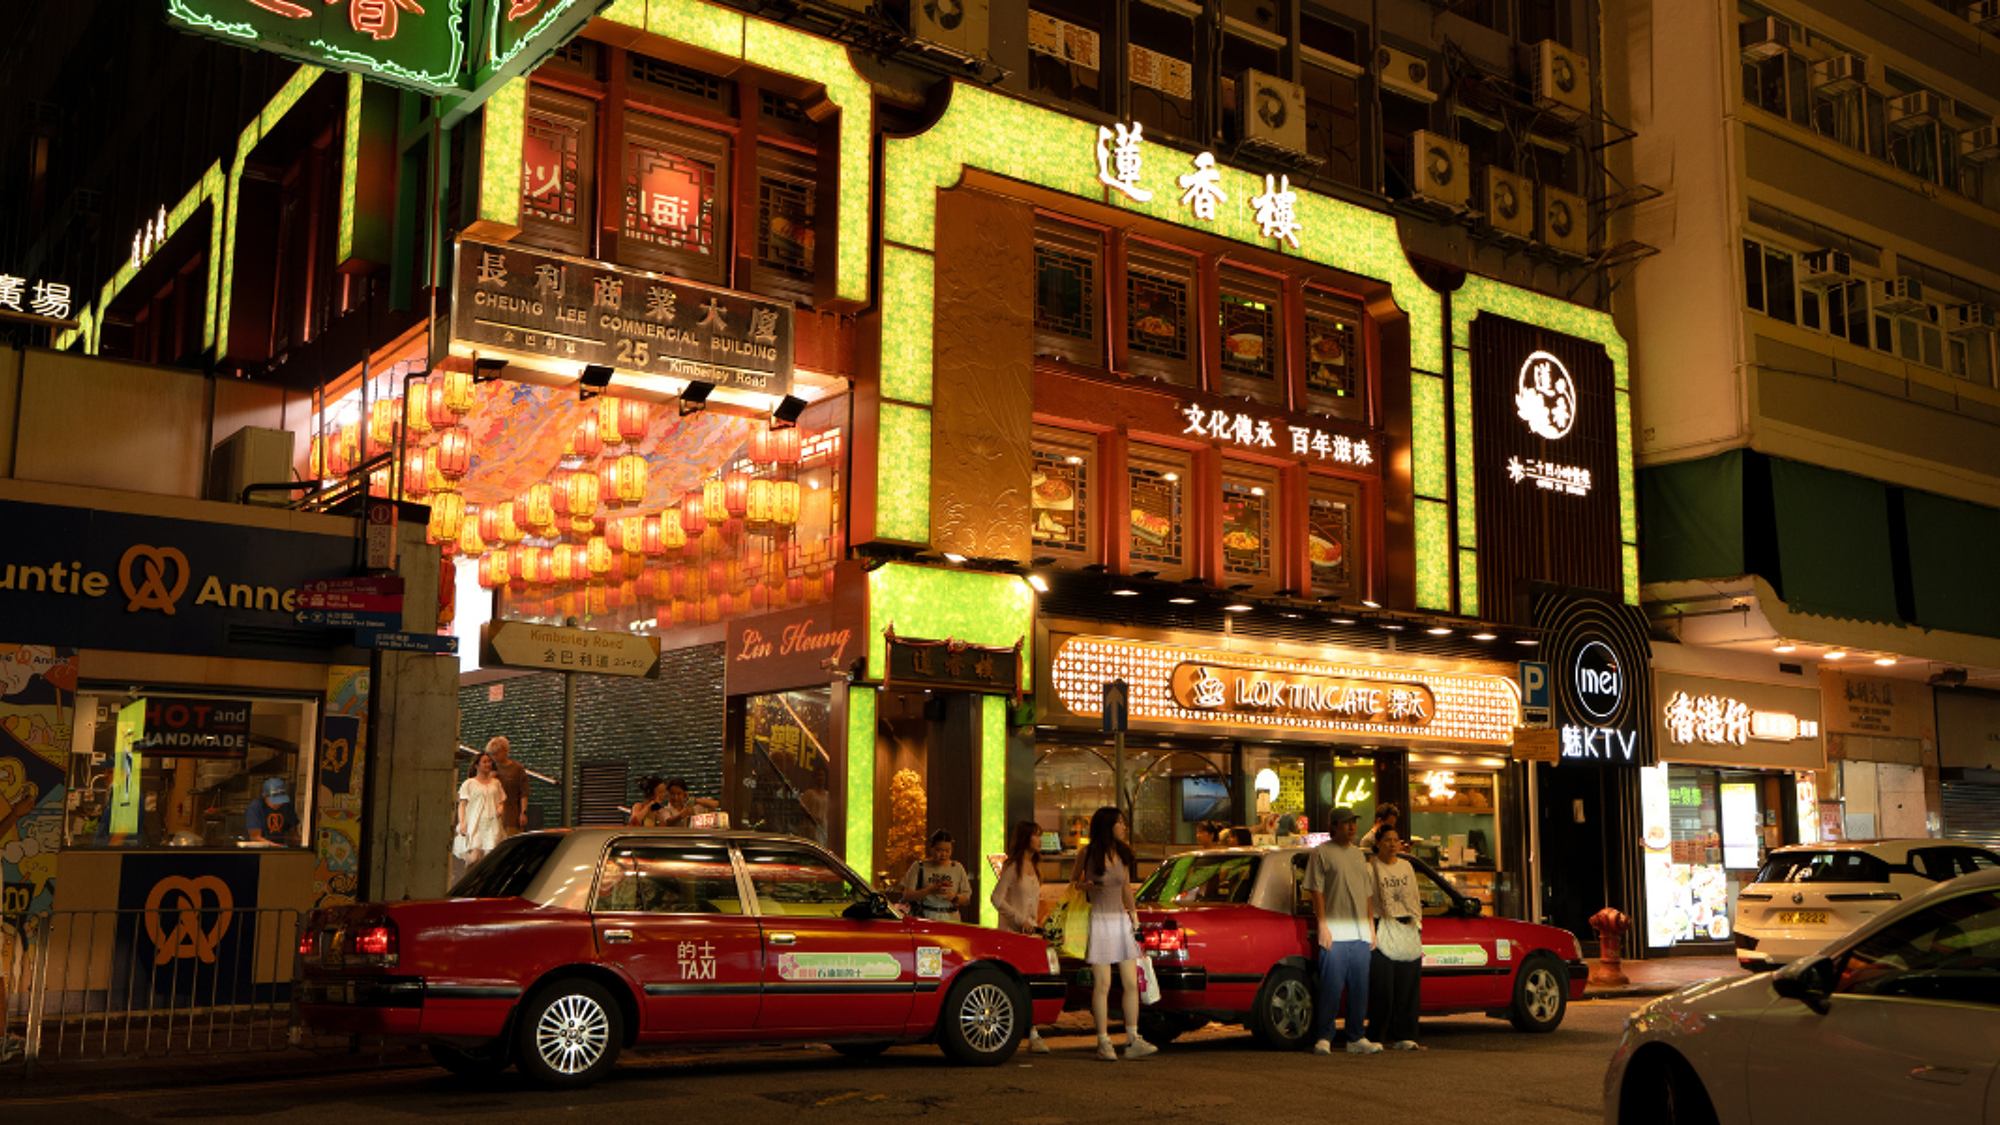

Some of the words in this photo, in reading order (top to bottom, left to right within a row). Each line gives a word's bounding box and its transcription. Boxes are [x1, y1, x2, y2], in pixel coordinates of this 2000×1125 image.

[1096, 121, 1303, 248] 蓮香樓
[477, 250, 780, 343] 長利商業大廈
[474, 291, 544, 317] CHEUNG
[555, 306, 588, 325] LEE
[599, 313, 700, 347] COMMERCIAL
[710, 335, 778, 362] BUILDING
[616, 339, 650, 367] 25
[669, 359, 729, 385] Kimberley
[735, 371, 767, 388] Road
[1182, 402, 1276, 448] 文化傳承
[1288, 424, 1374, 467] 百年滋味
[530, 629, 590, 647] Kimberley
[593, 636, 624, 649] Road
[736, 628, 774, 661] Lin
[780, 620, 852, 660] Heung
[544, 649, 609, 668] 金巴利道
[912, 649, 995, 681] 蓮香樓
[1524, 664, 1545, 704] P
[1581, 664, 1618, 696] mei
[213, 708, 247, 723] and
[677, 940, 716, 960] 的士
[678, 960, 717, 980] TAXI
